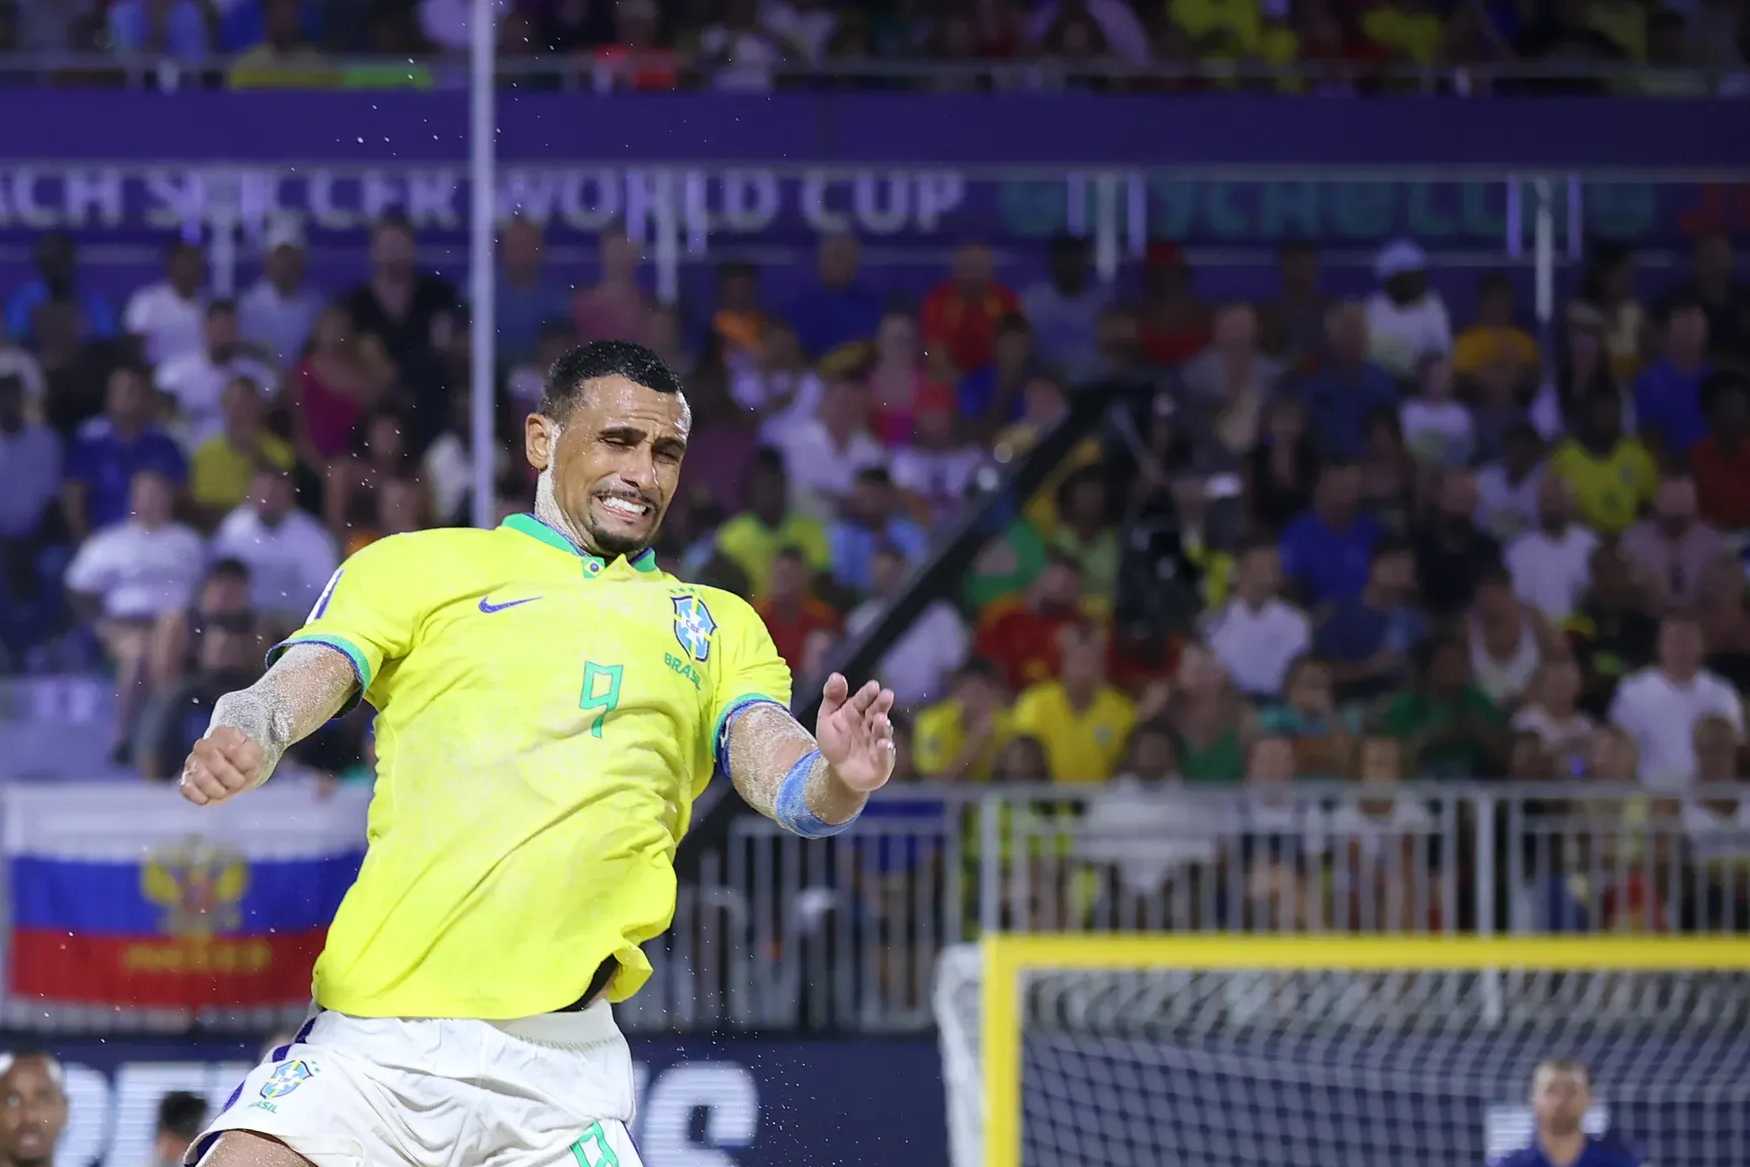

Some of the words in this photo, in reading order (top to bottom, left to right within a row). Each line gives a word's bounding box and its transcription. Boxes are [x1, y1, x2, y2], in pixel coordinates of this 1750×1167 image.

[146, 165, 458, 230] SCCER
[800, 166, 967, 235] CUP
[579, 660, 624, 739] 9
